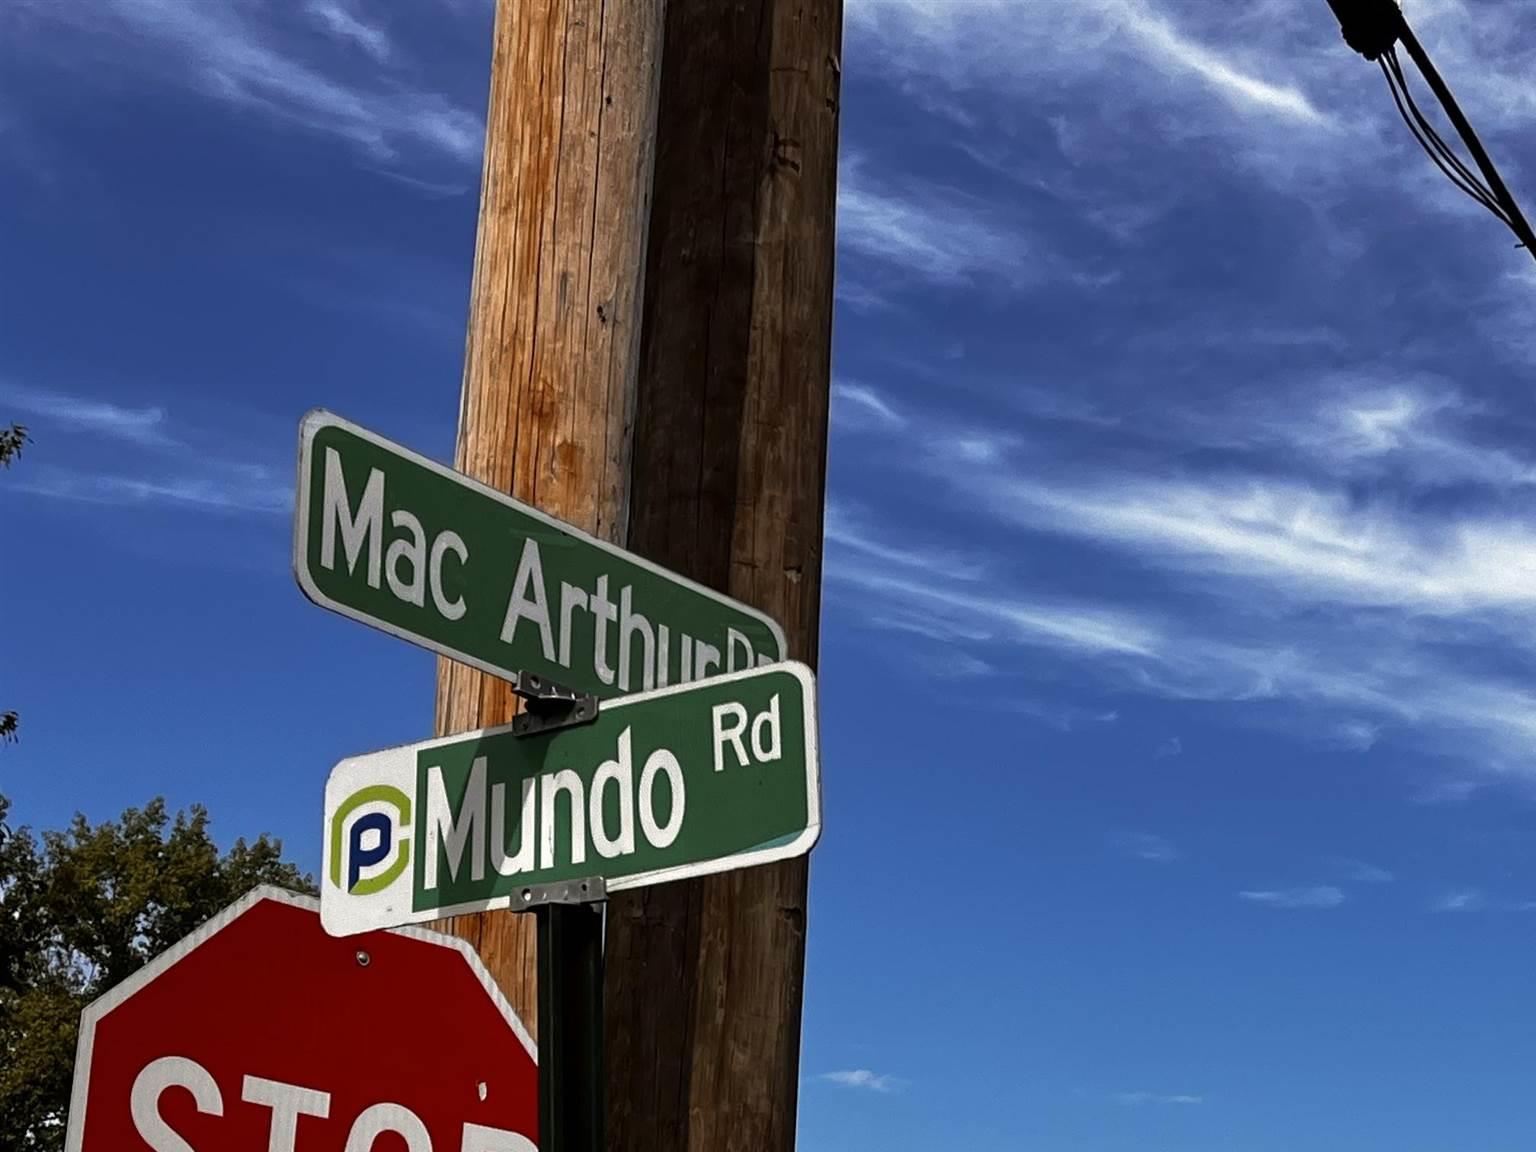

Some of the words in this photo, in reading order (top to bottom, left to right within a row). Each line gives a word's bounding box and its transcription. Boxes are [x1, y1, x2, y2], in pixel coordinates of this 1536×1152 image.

[320, 446, 470, 621] Mac
[500, 537, 721, 692] Arthur
[727, 626, 775, 674] D
[424, 725, 686, 890] Mundo
[712, 693, 783, 772] Rd
